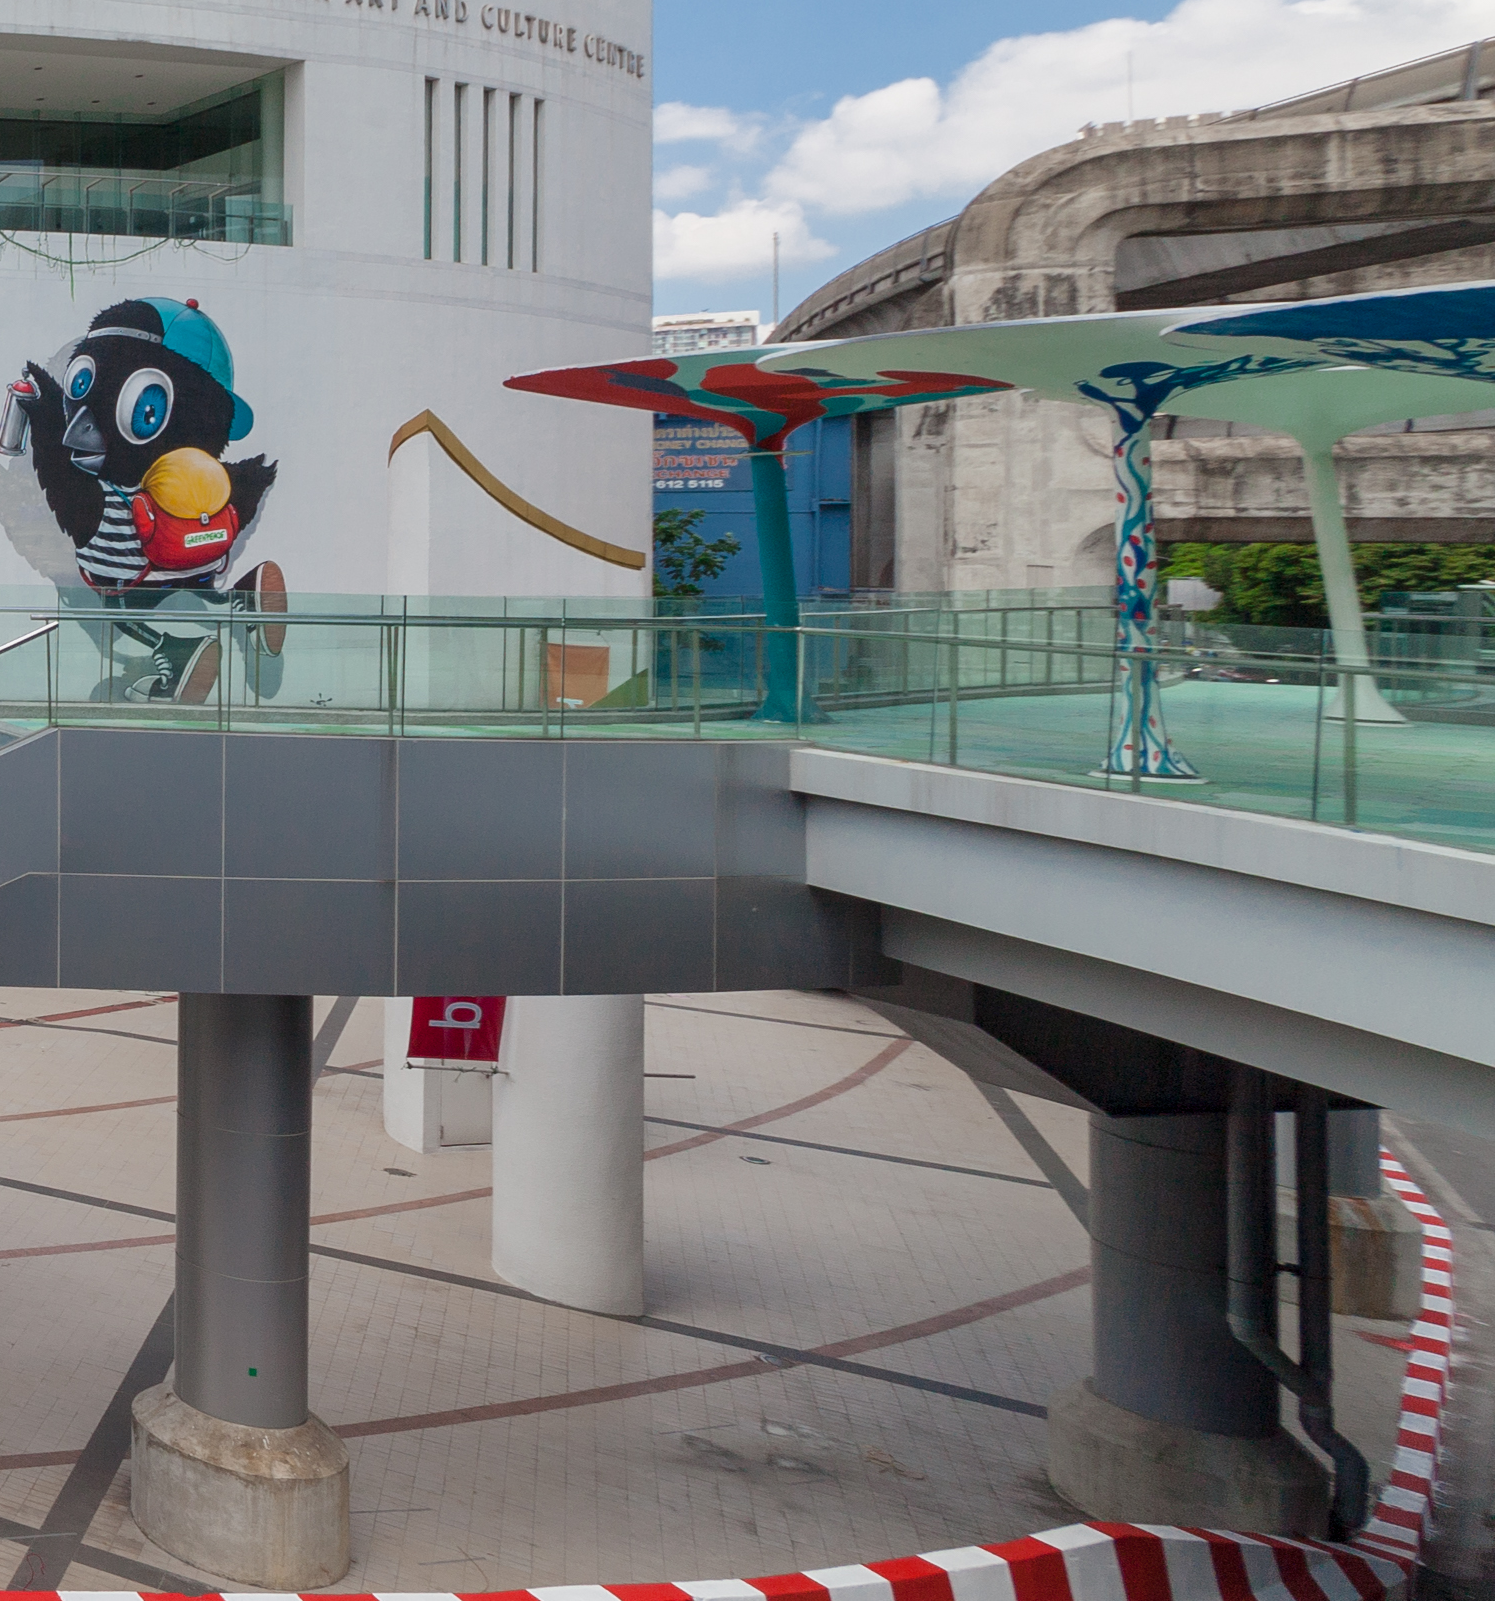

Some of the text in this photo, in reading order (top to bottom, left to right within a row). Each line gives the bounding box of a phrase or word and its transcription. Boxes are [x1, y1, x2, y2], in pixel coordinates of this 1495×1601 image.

[480, 3, 578, 53] CULTURE
[583, 34, 646, 79] CENTRE
[688, 479, 724, 489] 5115
